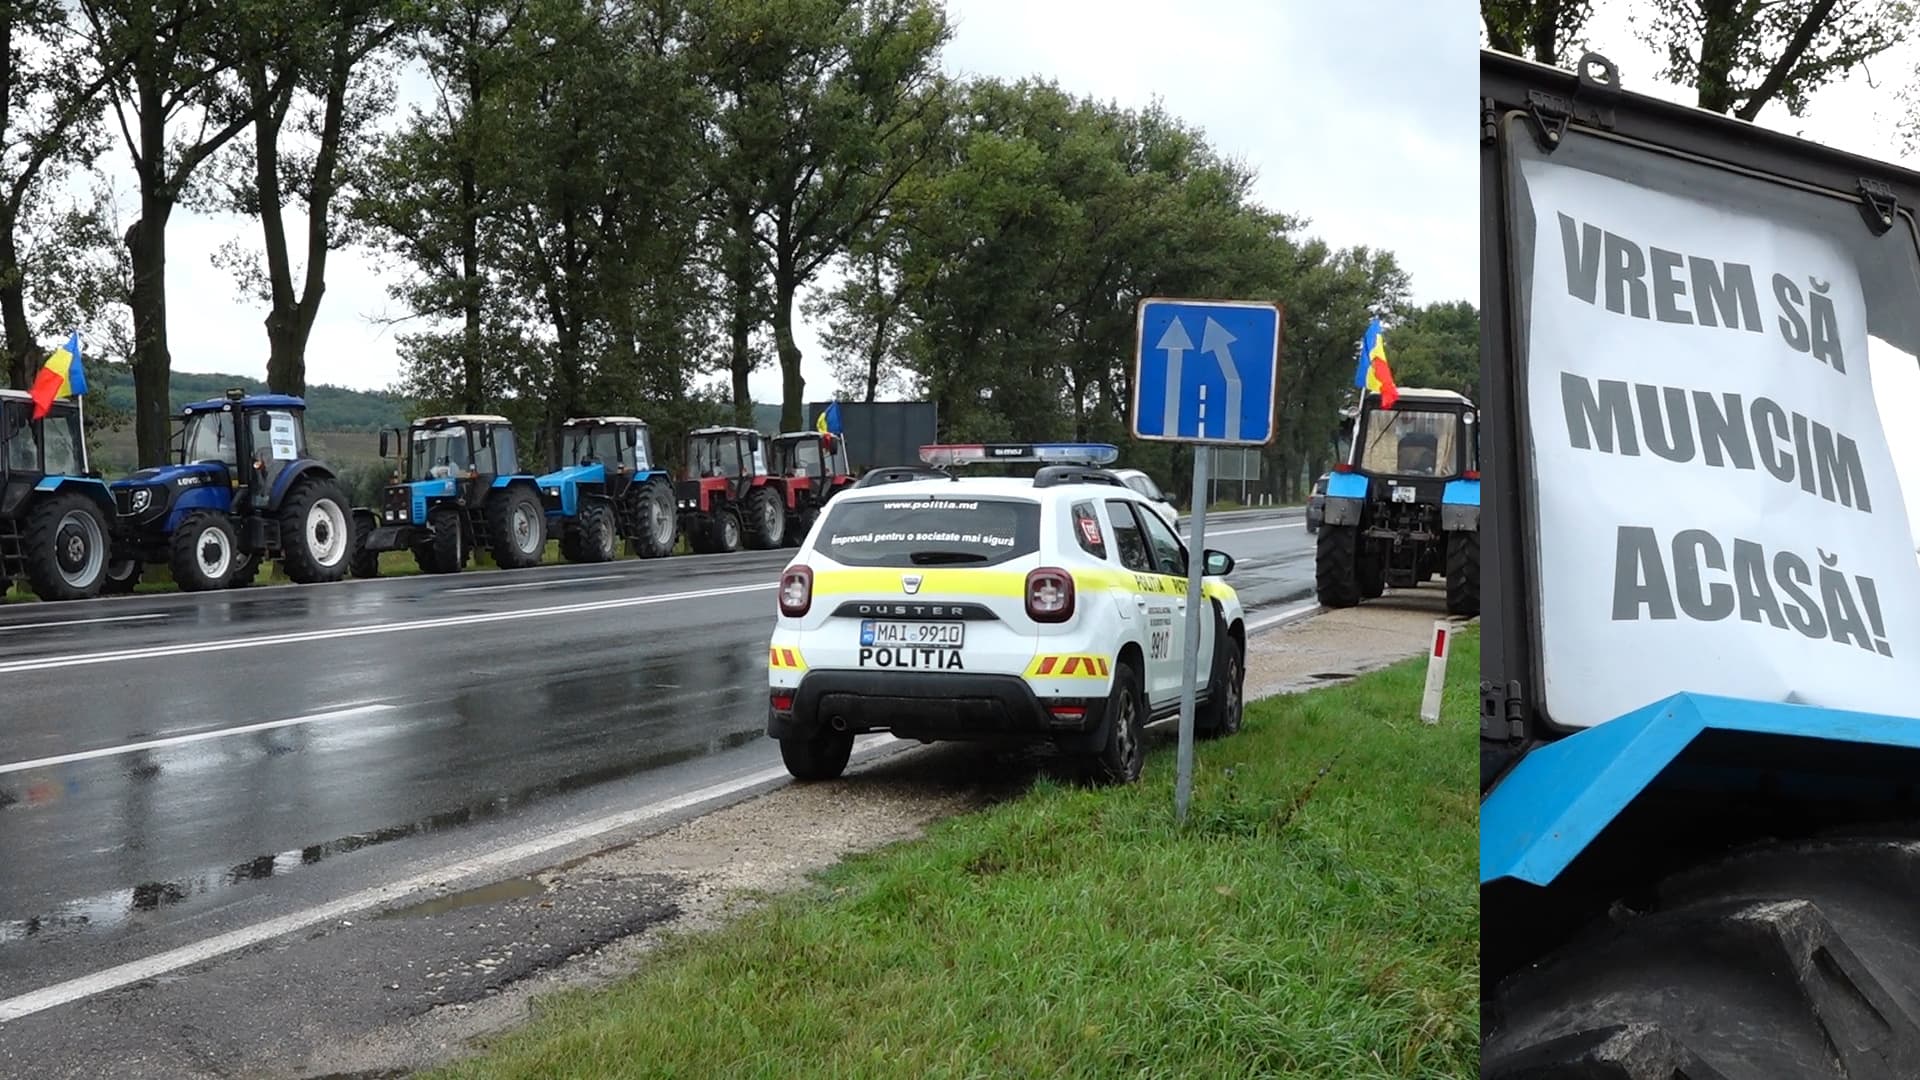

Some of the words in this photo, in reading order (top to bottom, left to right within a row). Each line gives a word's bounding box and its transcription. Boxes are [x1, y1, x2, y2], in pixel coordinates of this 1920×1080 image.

[1557, 210, 1764, 333] VREM
[1771, 273, 1846, 376] SĂ
[1560, 371, 1872, 514] MUNCIM
[874, 532, 905, 543] pentru
[907, 533, 913, 541] o
[915, 531, 960, 542] societate
[961, 533, 980, 542] mai
[982, 535, 1015, 547] sigură
[859, 605, 963, 615] DUSTER
[1611, 525, 1894, 659] ACASĂ!
[877, 624, 907, 641] MAI
[919, 625, 959, 643] 9910
